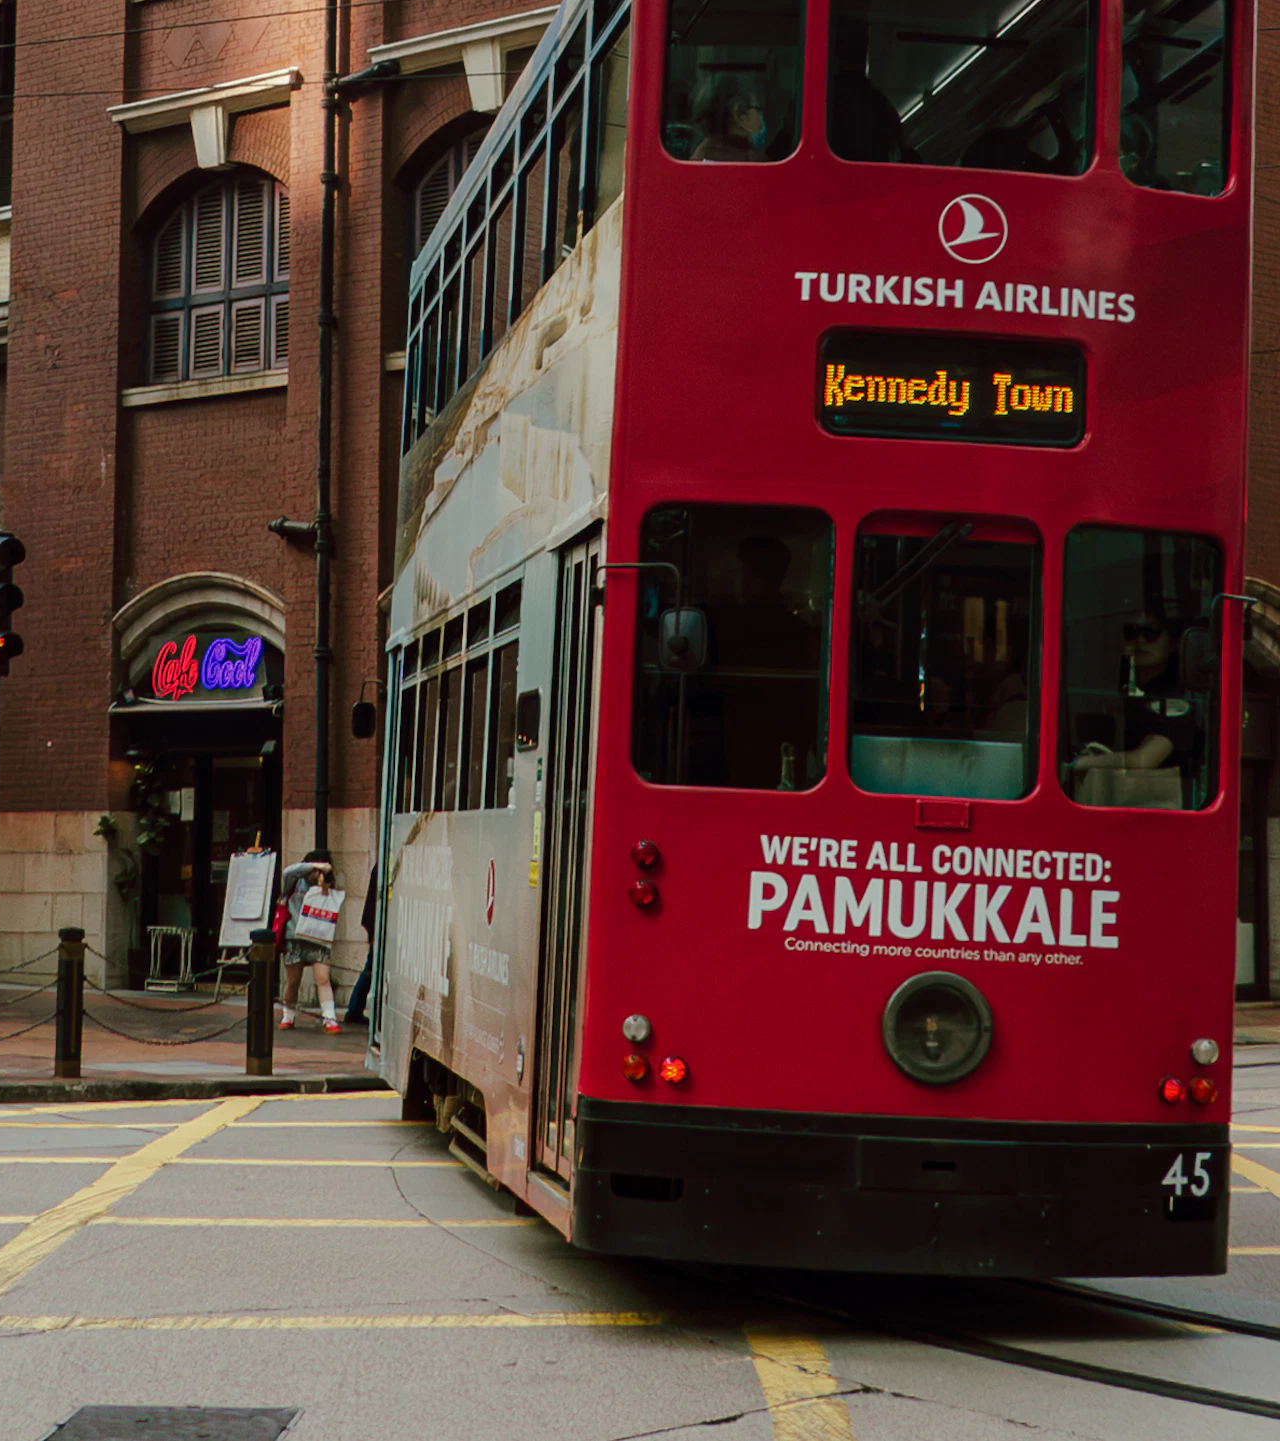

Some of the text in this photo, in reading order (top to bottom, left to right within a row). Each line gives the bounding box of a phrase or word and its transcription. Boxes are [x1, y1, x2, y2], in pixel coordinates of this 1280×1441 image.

[794, 272, 1136, 323] TURKISH AIRLINES
[824, 364, 1074, 416] Kennedy Town
[201, 637, 263, 691] Cool
[760, 834, 1112, 883] WE'RE ALL CONNECTED:
[747, 870, 1120, 949] PAMUKKALE
[784, 937, 1083, 966] Connecting more countries than any other.
[1161, 1152, 1212, 1197] 45
